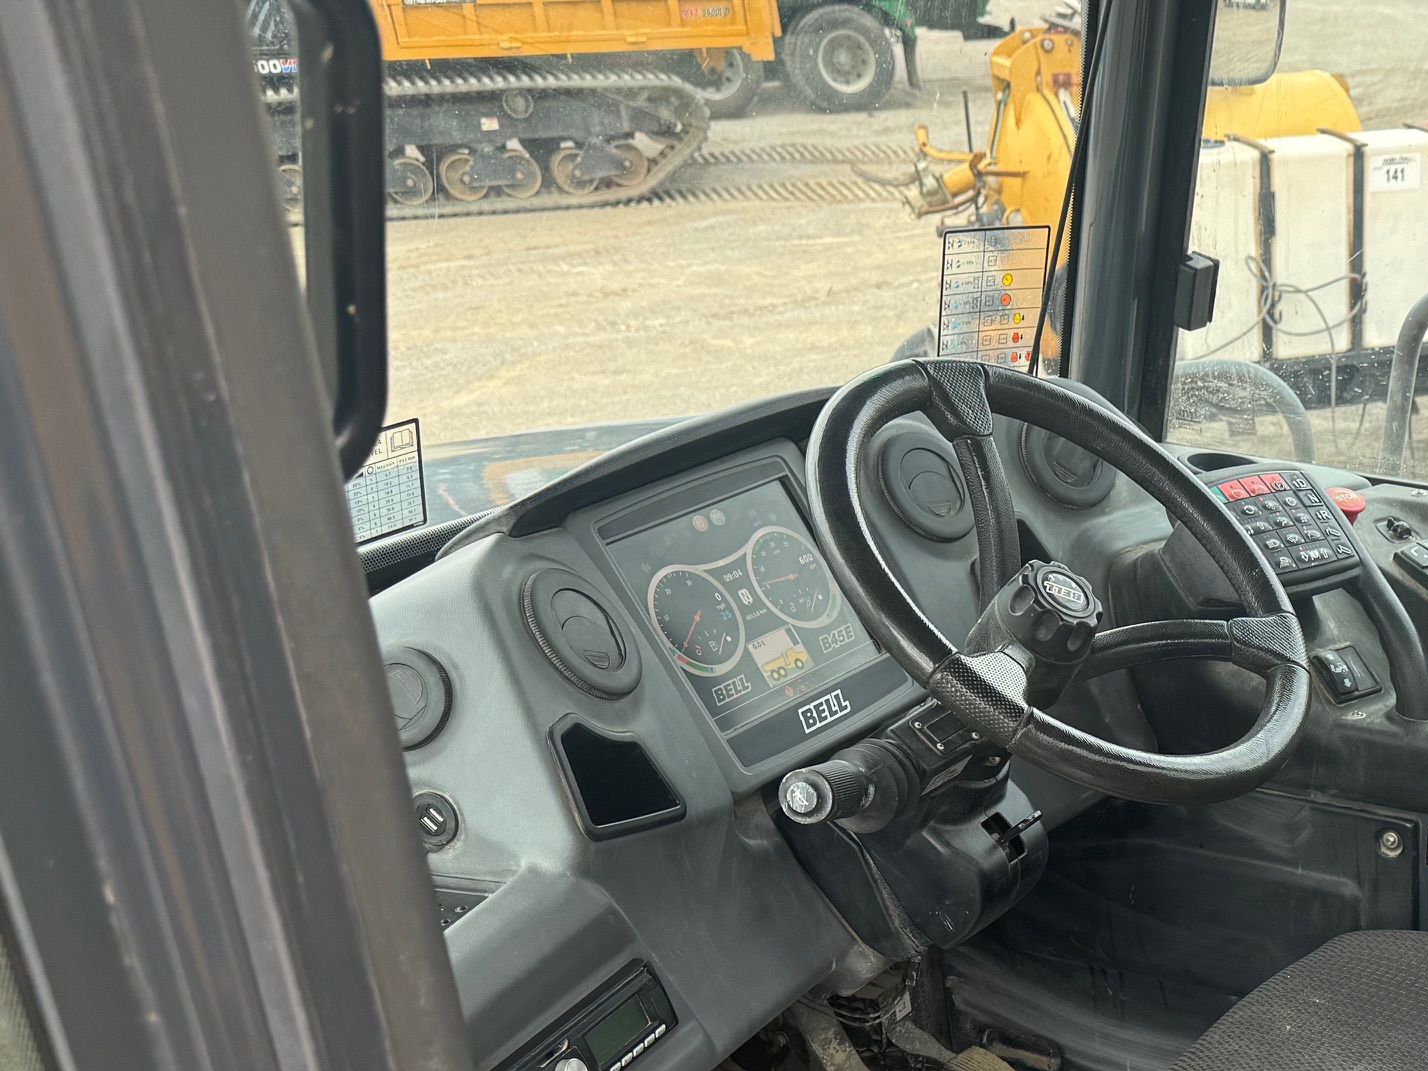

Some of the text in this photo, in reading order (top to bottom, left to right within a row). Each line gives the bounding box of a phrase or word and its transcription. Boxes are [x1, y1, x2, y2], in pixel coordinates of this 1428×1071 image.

[1386, 168, 1405, 183] 141
[1308, 494, 1319, 502] N
[798, 553, 814, 565] 600
[723, 569, 743, 583] 09:04
[1043, 580, 1085, 604] BELL
[819, 624, 855, 653] B45E
[712, 674, 752, 706] BELL
[797, 689, 851, 734] BELL
